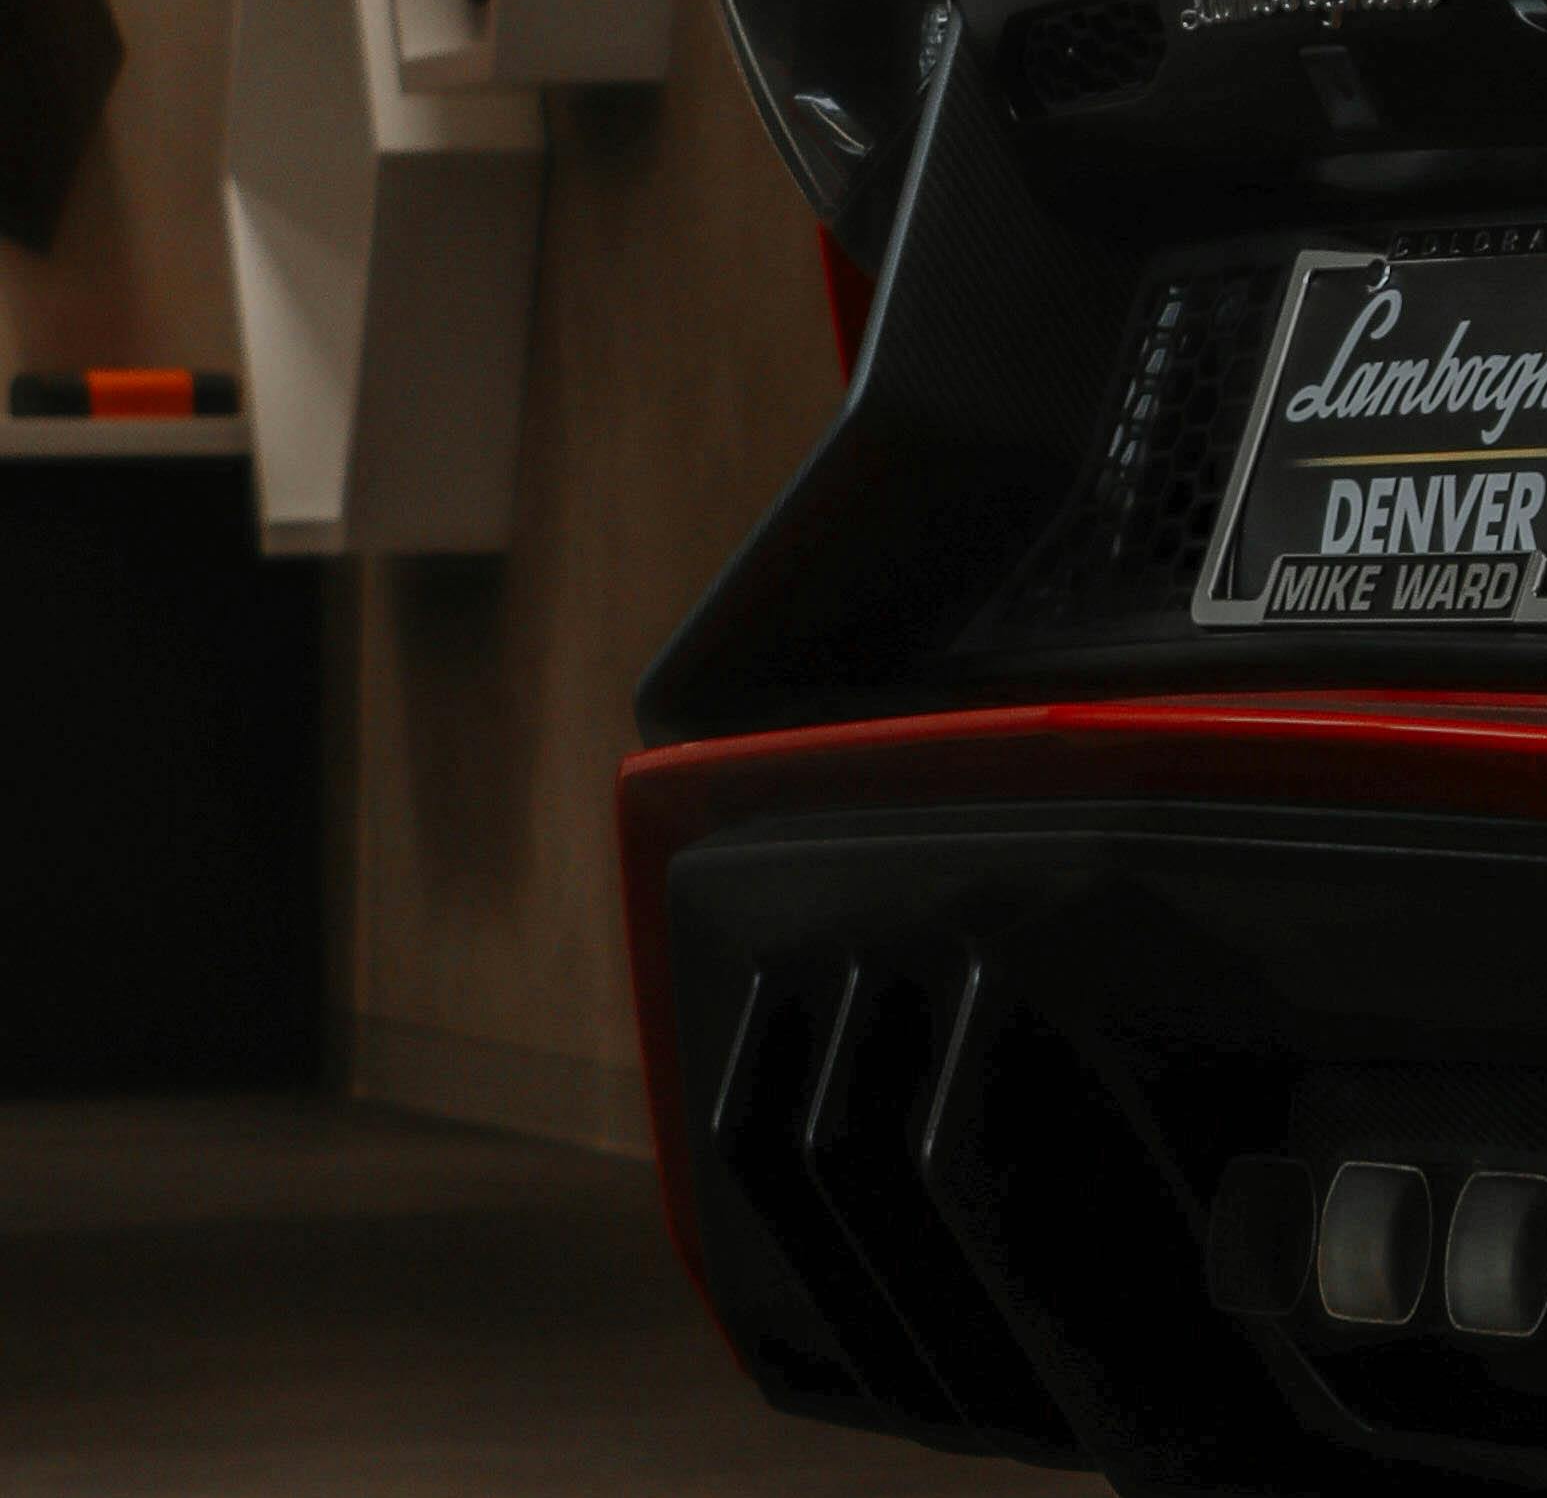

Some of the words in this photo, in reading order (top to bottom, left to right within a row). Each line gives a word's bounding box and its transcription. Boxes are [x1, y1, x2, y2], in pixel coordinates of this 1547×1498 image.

[1320, 471, 1546, 555] DENVER
[1273, 565, 1381, 611] MIKE
[1392, 562, 1520, 610] WARD
